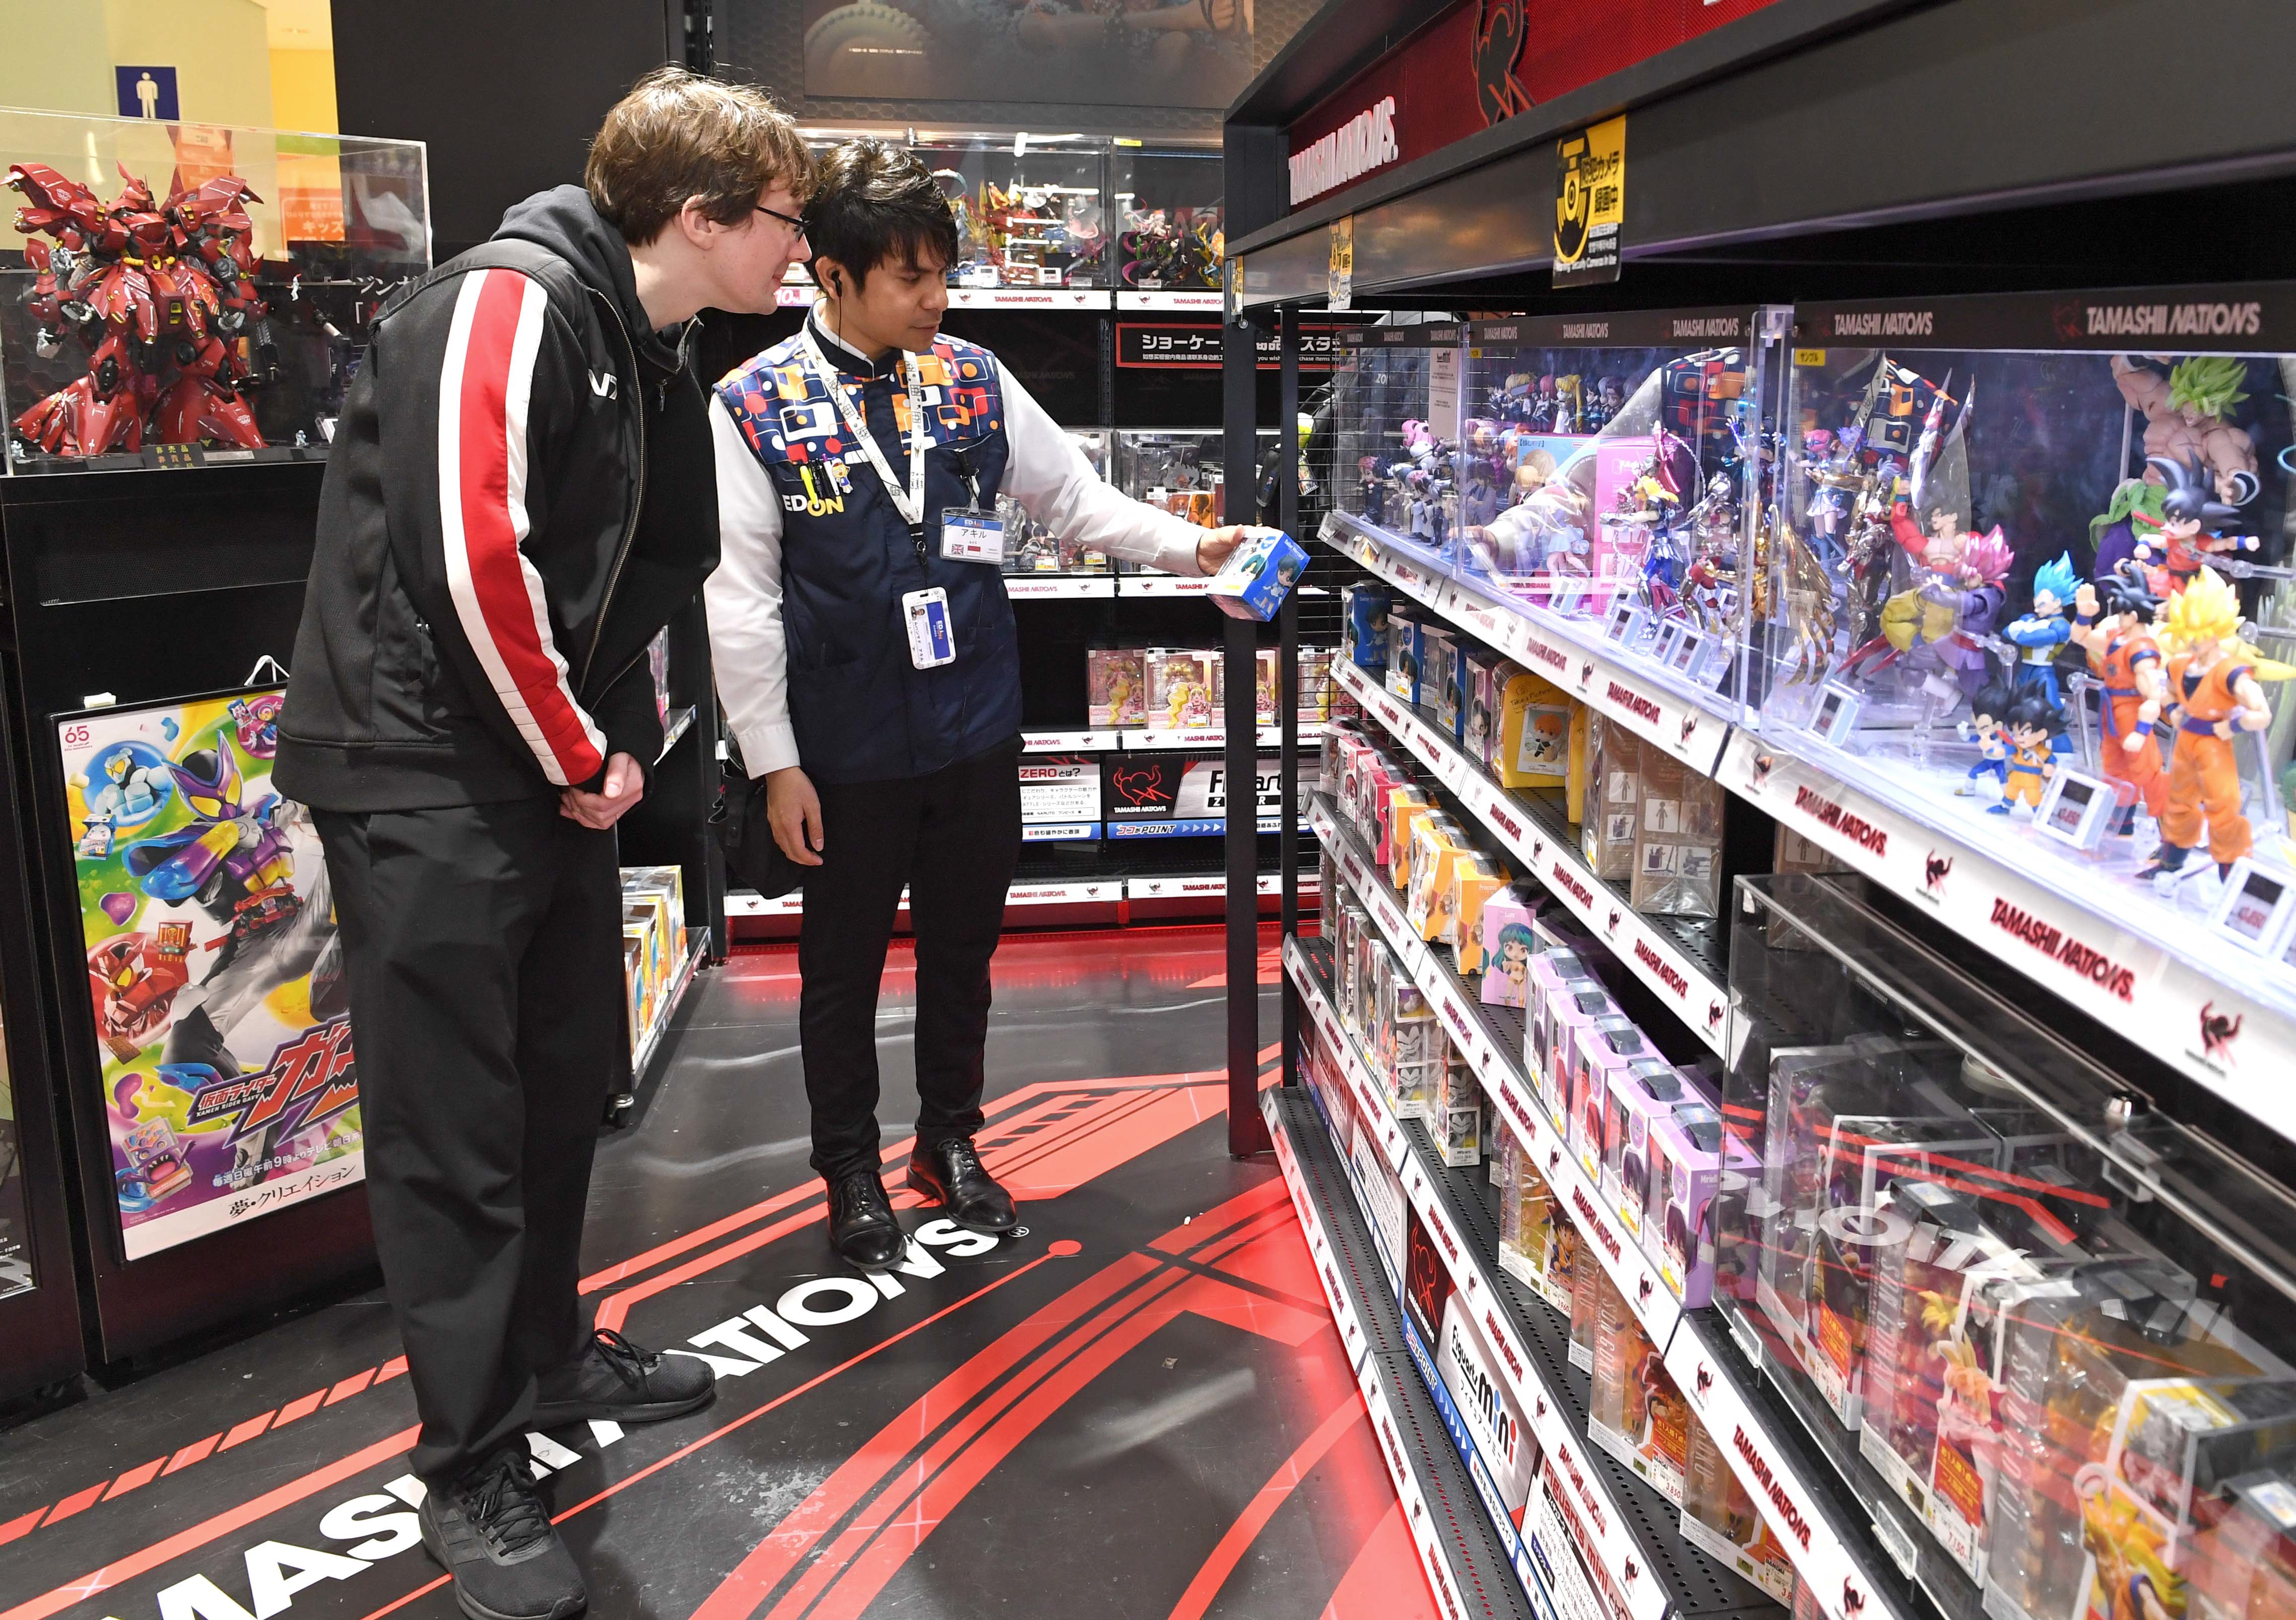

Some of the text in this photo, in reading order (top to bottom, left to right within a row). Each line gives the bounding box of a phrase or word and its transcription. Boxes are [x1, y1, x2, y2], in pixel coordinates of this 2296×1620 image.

[1288, 132, 1336, 205] TAMASHII
[1563, 322, 1609, 339] TAMASHII NATIONS
[1672, 317, 1739, 337] TAMASHII NATIONS
[1834, 312, 1933, 335] TAMASHII NATIONS
[2087, 302, 2261, 336] TAMASHII NATIONS
[1142, 334, 1223, 350] ショーケー
[1484, 327, 1501, 339] TAMASHII
[961, 529, 986, 538] アキル
[1606, 681, 1633, 709] TAMASHII
[65, 725, 90, 744] 65
[1020, 768, 1057, 778] ZERO
[1139, 805, 1167, 814] NATIONS
[1795, 786, 1887, 857] TAMASHII NATIONS.
[781, 900, 804, 908] TAMAS
[1634, 938, 1663, 977] TAMASHII
[1991, 897, 2136, 1005] TAMASHII NATIONS.
[196, 1093, 261, 1118] KAMEN RIDER GAVV
[198, 1074, 277, 1111] 仮面ライダー
[1572, 1185, 1622, 1265] TAMASHII NATIONS
[1579, 1267, 1596, 1309] GOKU
[1597, 1298, 1617, 1384] SON GOKU
[1451, 1324, 1517, 1466] Figuarts mini
[1653, 1454, 1668, 1469] BANDAI
[1733, 1423, 1811, 1554] TAMASHII NATIONS.
[1545, 1457, 1585, 1550] Figuarts
[1586, 1541, 1609, 1596] mini
[1765, 1558, 1785, 1575] BANDAI
